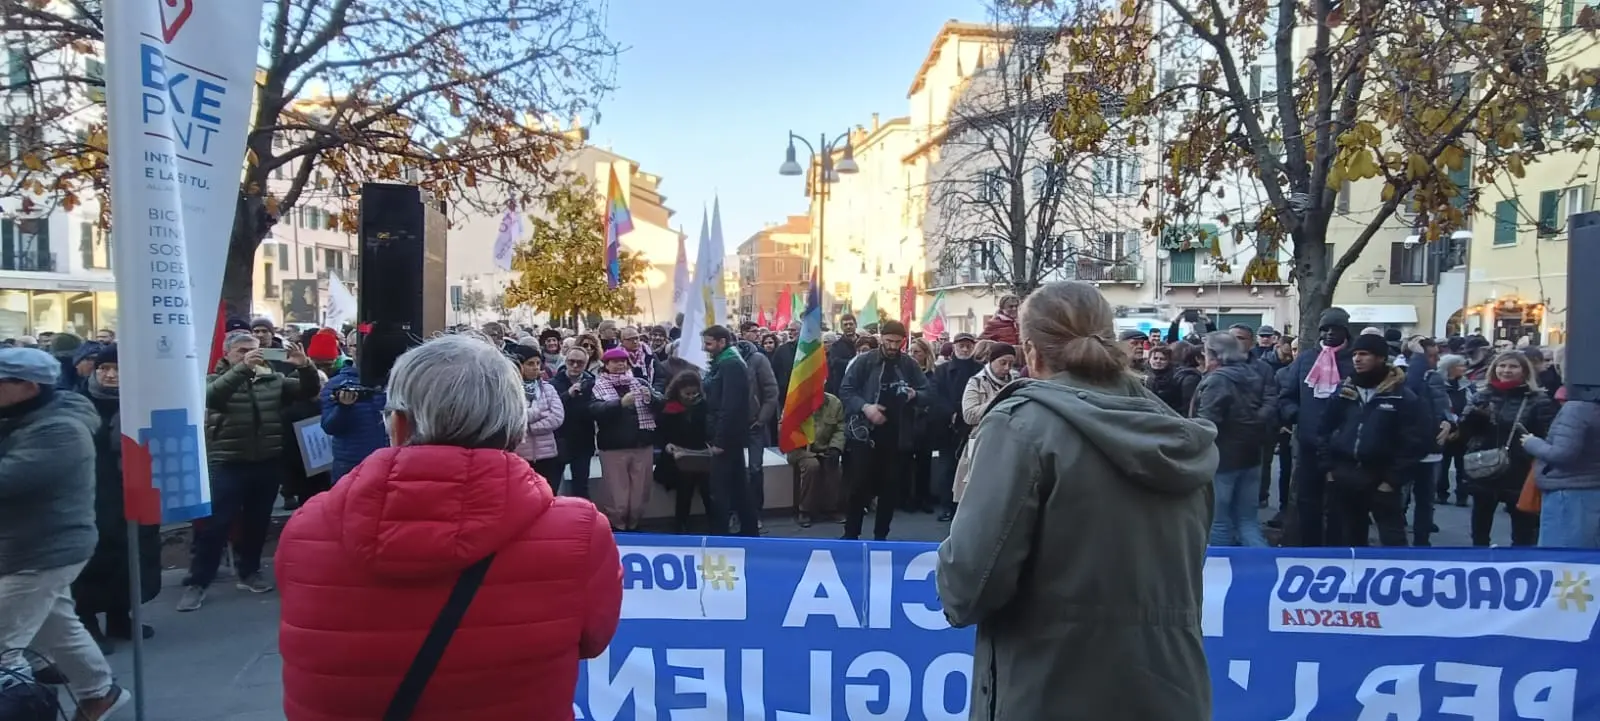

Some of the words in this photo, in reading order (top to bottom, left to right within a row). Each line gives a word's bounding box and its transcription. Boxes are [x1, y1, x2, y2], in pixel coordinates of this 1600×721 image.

[145, 167, 154, 178] E
[190, 175, 210, 190] TU.
[148, 208, 177, 222] BIC
[149, 225, 179, 239] ITIN
[149, 243, 182, 257] SOS
[151, 278, 186, 290] RIPA
[152, 295, 190, 308] PEDA
[153, 313, 163, 325] E
[168, 313, 192, 326] FEL
